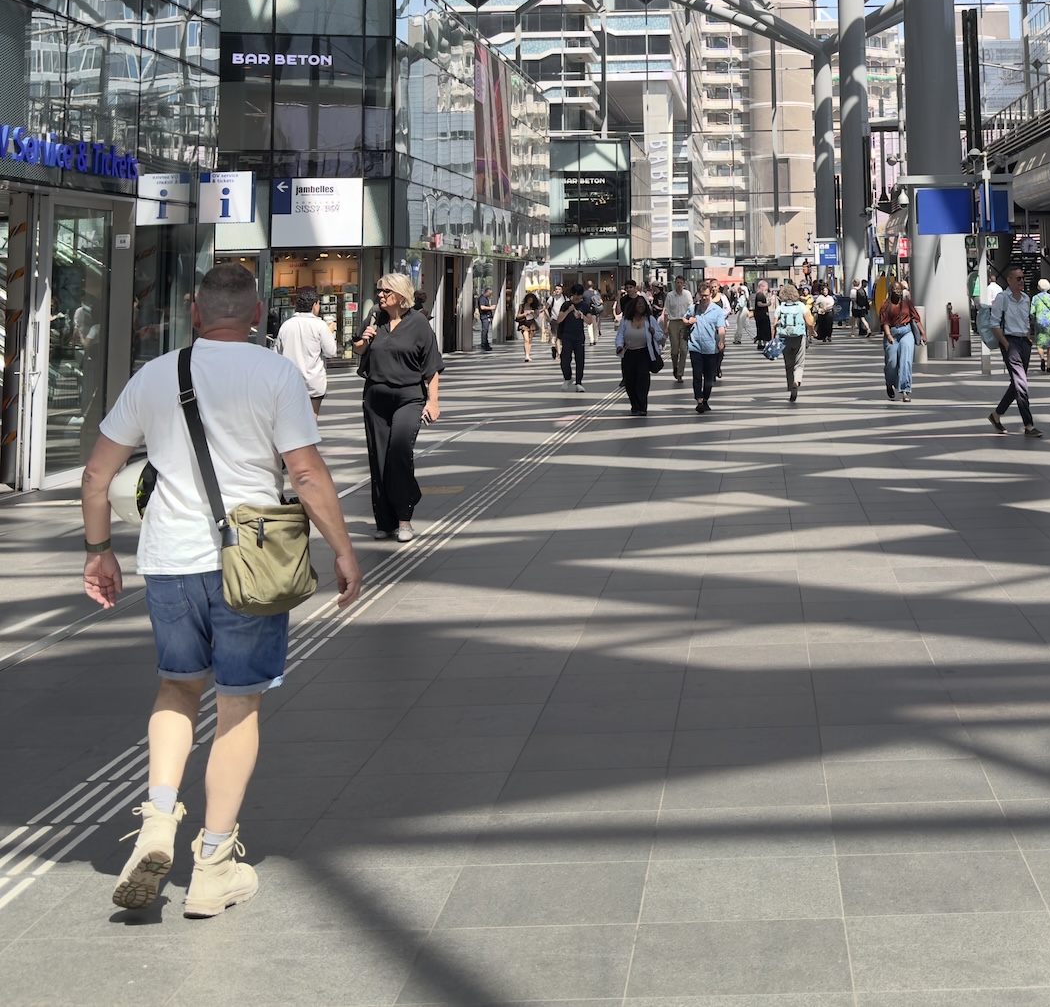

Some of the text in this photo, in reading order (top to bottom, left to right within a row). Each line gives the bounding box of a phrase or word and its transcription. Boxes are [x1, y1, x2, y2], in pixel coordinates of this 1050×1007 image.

[232, 53, 332, 65] BAR BETON
[12, 127, 73, 169] Service
[77, 141, 88, 173] &
[91, 143, 138, 180] Tickets
[296, 186, 334, 196] jambelles
[649, 140, 668, 239] BABYLON
